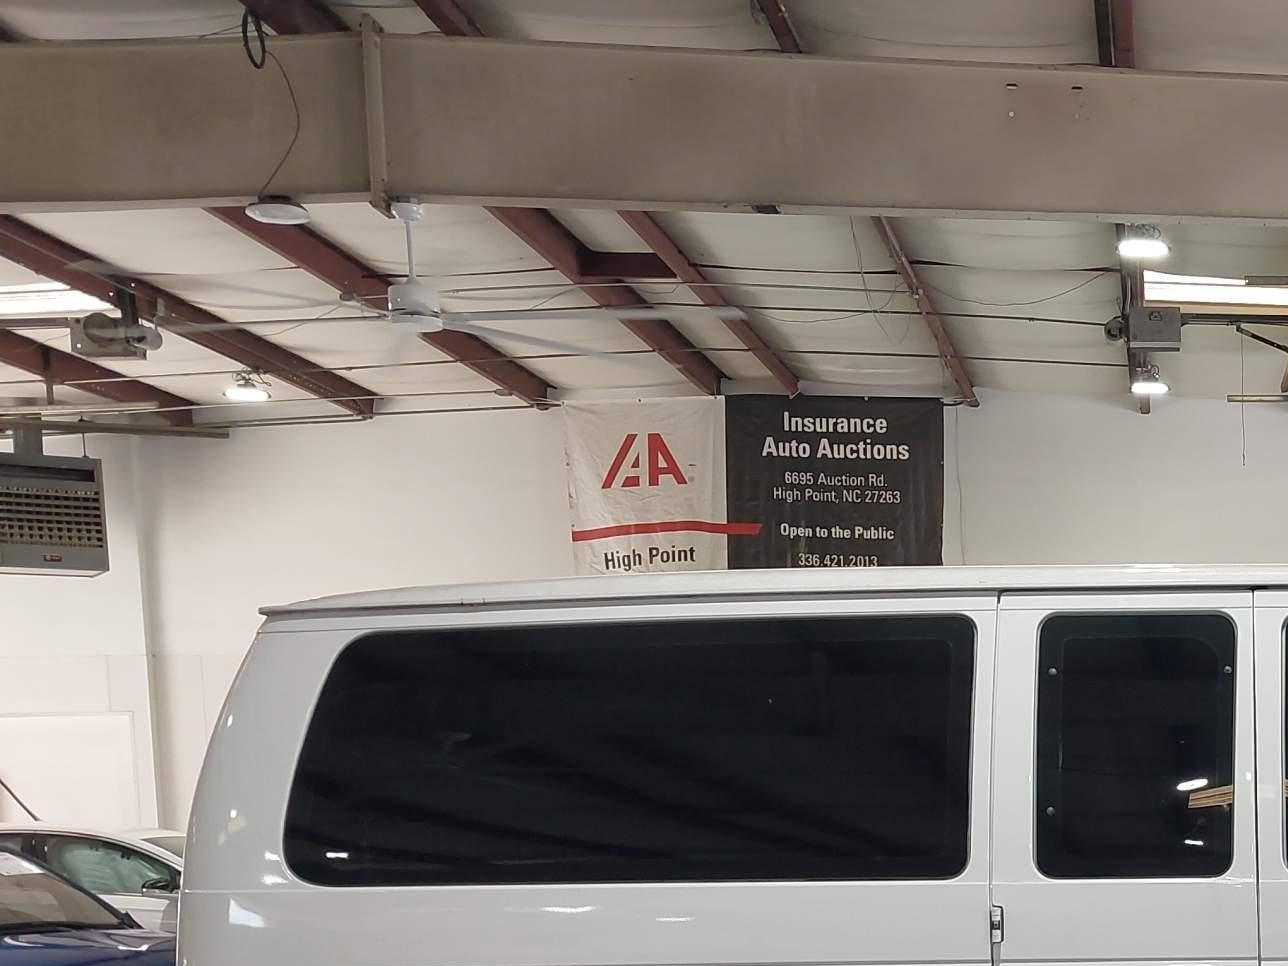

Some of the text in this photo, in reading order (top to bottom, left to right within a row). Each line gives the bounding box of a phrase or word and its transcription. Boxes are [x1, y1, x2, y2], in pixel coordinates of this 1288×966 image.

[783, 411, 888, 434] Insurance
[762, 436, 910, 460] Auto Auctions
[784, 471, 888, 487] 6695 Auction Rd.
[773, 487, 901, 505] High Point, NC 27263
[780, 523, 894, 540] Open to the Public
[604, 545, 696, 573] High Point
[798, 552, 878, 567] 336.421.2013
